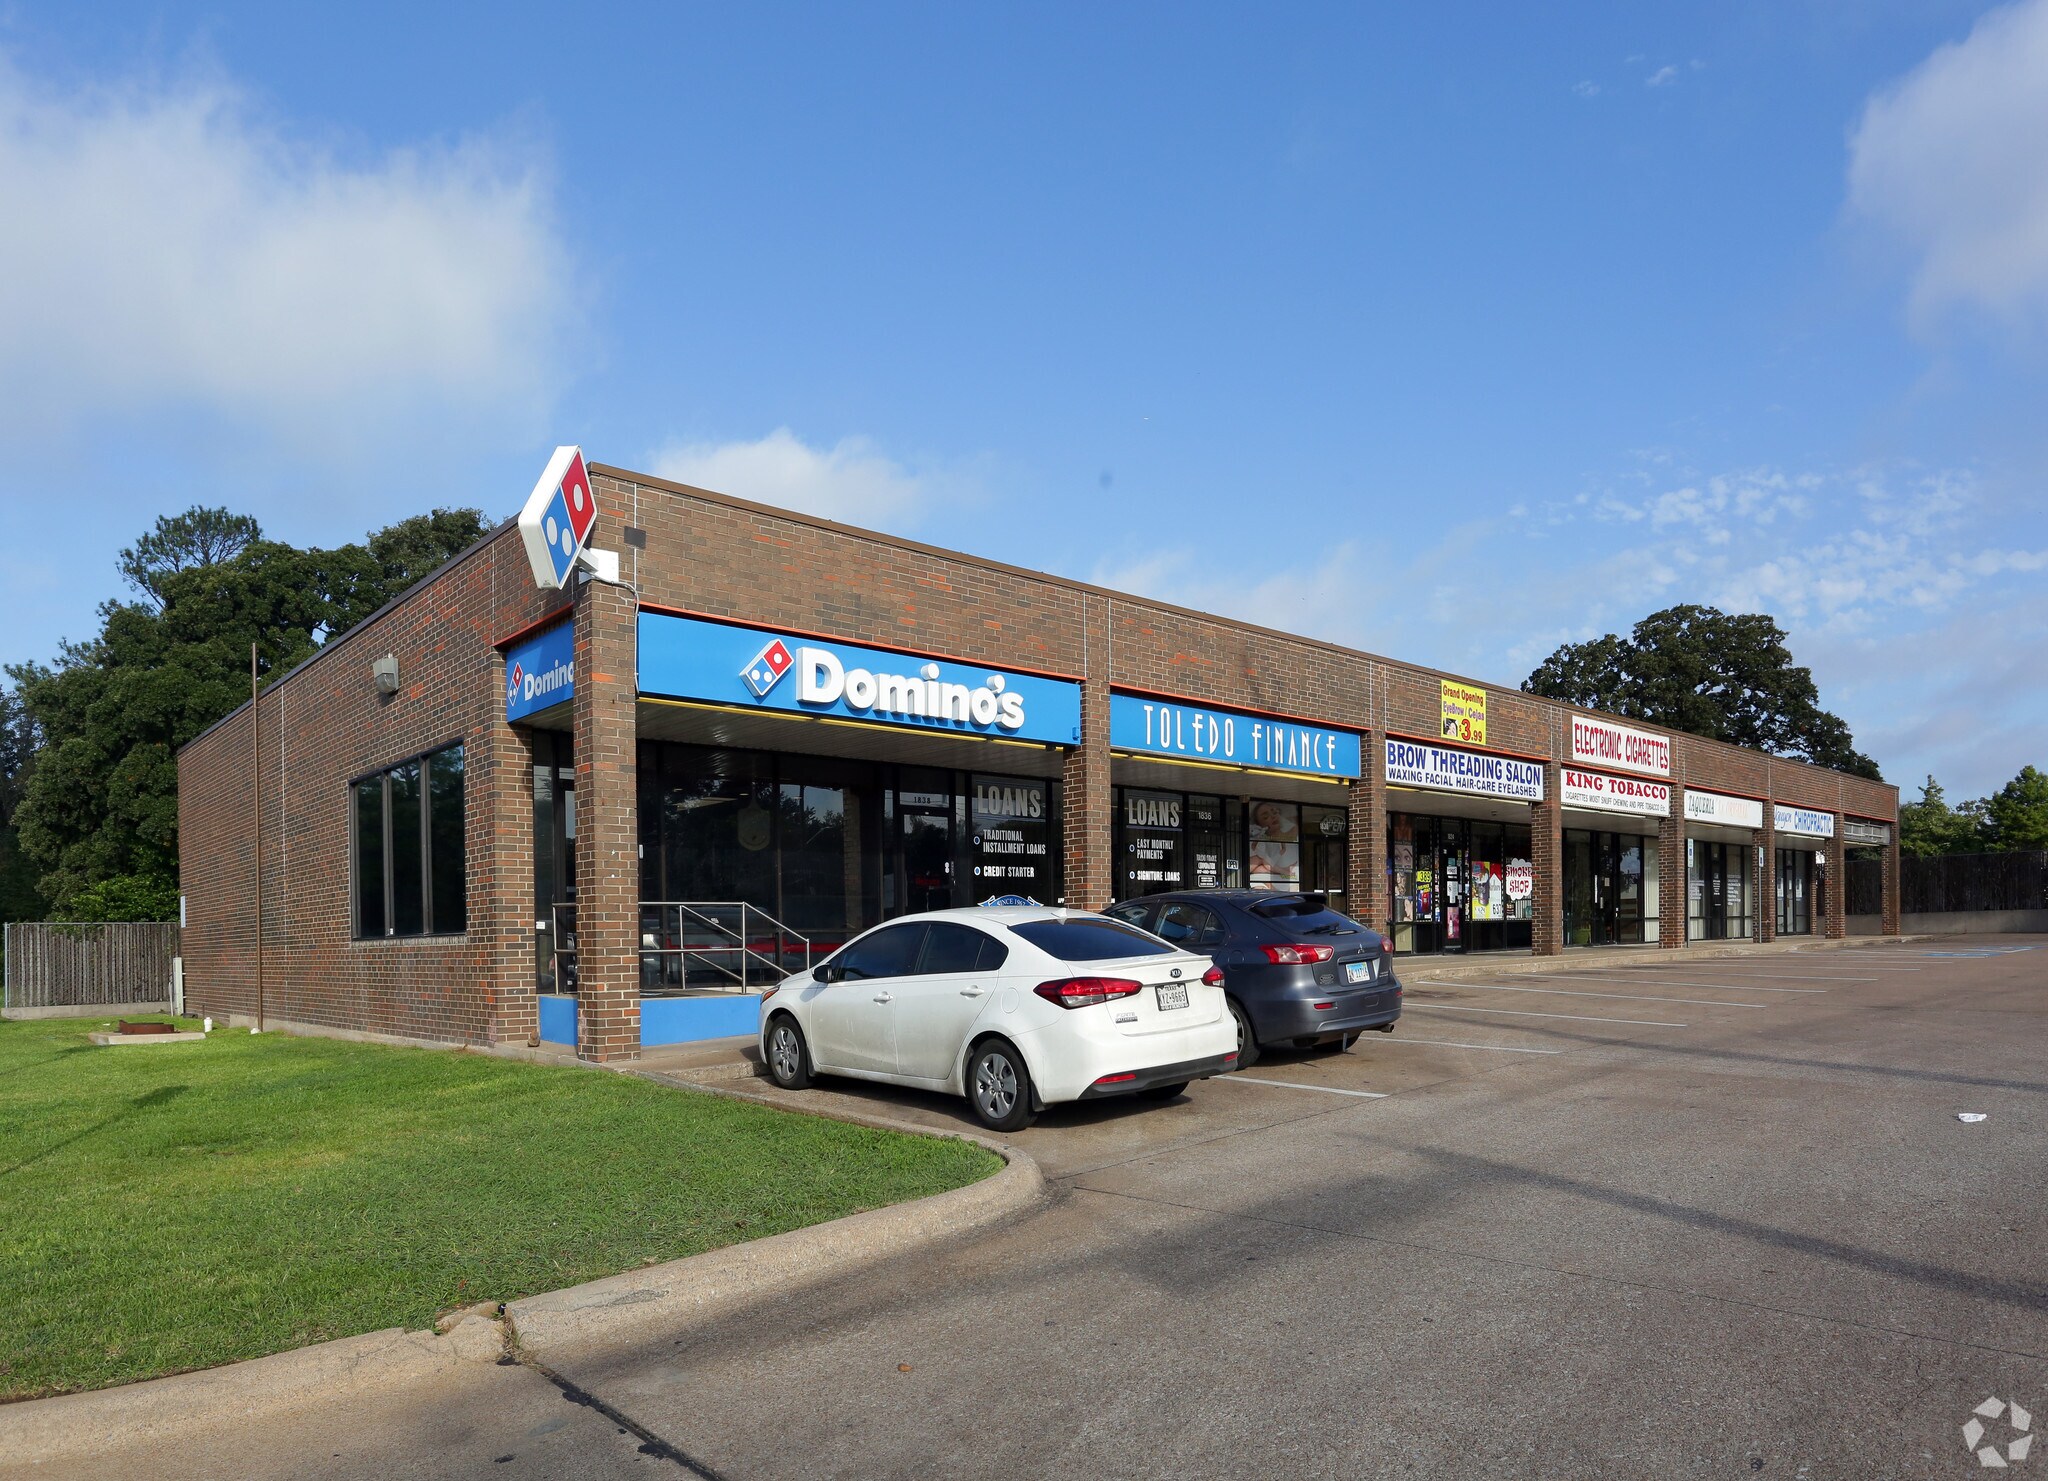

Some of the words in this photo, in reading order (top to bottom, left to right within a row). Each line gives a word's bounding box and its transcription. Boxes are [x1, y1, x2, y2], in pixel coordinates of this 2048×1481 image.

[796, 647, 1025, 729] Domino's
[1443, 684, 1460, 699] Grand
[1461, 689, 1483, 707] Opening
[1468, 707, 1484, 722] Cejas
[1143, 705, 1235, 757] TOLEDO
[1251, 723, 1336, 770] FINANCE
[1574, 722, 1622, 761] ELECTRONIC
[1625, 734, 1668, 770] CIGARETTES
[1387, 742, 1427, 770] BROW
[1431, 750, 1503, 781] THREADING
[1505, 761, 1541, 786] SALON
[1388, 767, 1423, 783] WAXING
[1425, 772, 1453, 787] FACIAL
[1456, 776, 1496, 792] HAIR-CARE
[1497, 782, 1537, 798] EYELASHES
[1566, 771, 1604, 791] KING
[1609, 779, 1667, 800] TOBACCO
[977, 785, 1041, 818] LOANS
[1128, 798, 1180, 827] LOANS
[1688, 795, 1715, 817] TAQUERIA
[1198, 811, 1212, 820] 1836
[1794, 810, 1832, 834] CHIROPRACTIC
[983, 829, 1023, 841] TRADITIONAL
[1137, 838, 1150, 849] EASY
[1151, 839, 1174, 850] MONTHLY
[983, 842, 1025, 854] INSTALLMENT
[1026, 843, 1046, 855] LOANS
[1137, 849, 1163, 860] PAYMENTS
[983, 865, 1006, 877] CREDIT
[1007, 866, 1035, 878] STARTER
[1164, 871, 1180, 882] LOANS
[1506, 866, 1533, 878] SMOKE
[1509, 879, 1530, 894] SHOP
